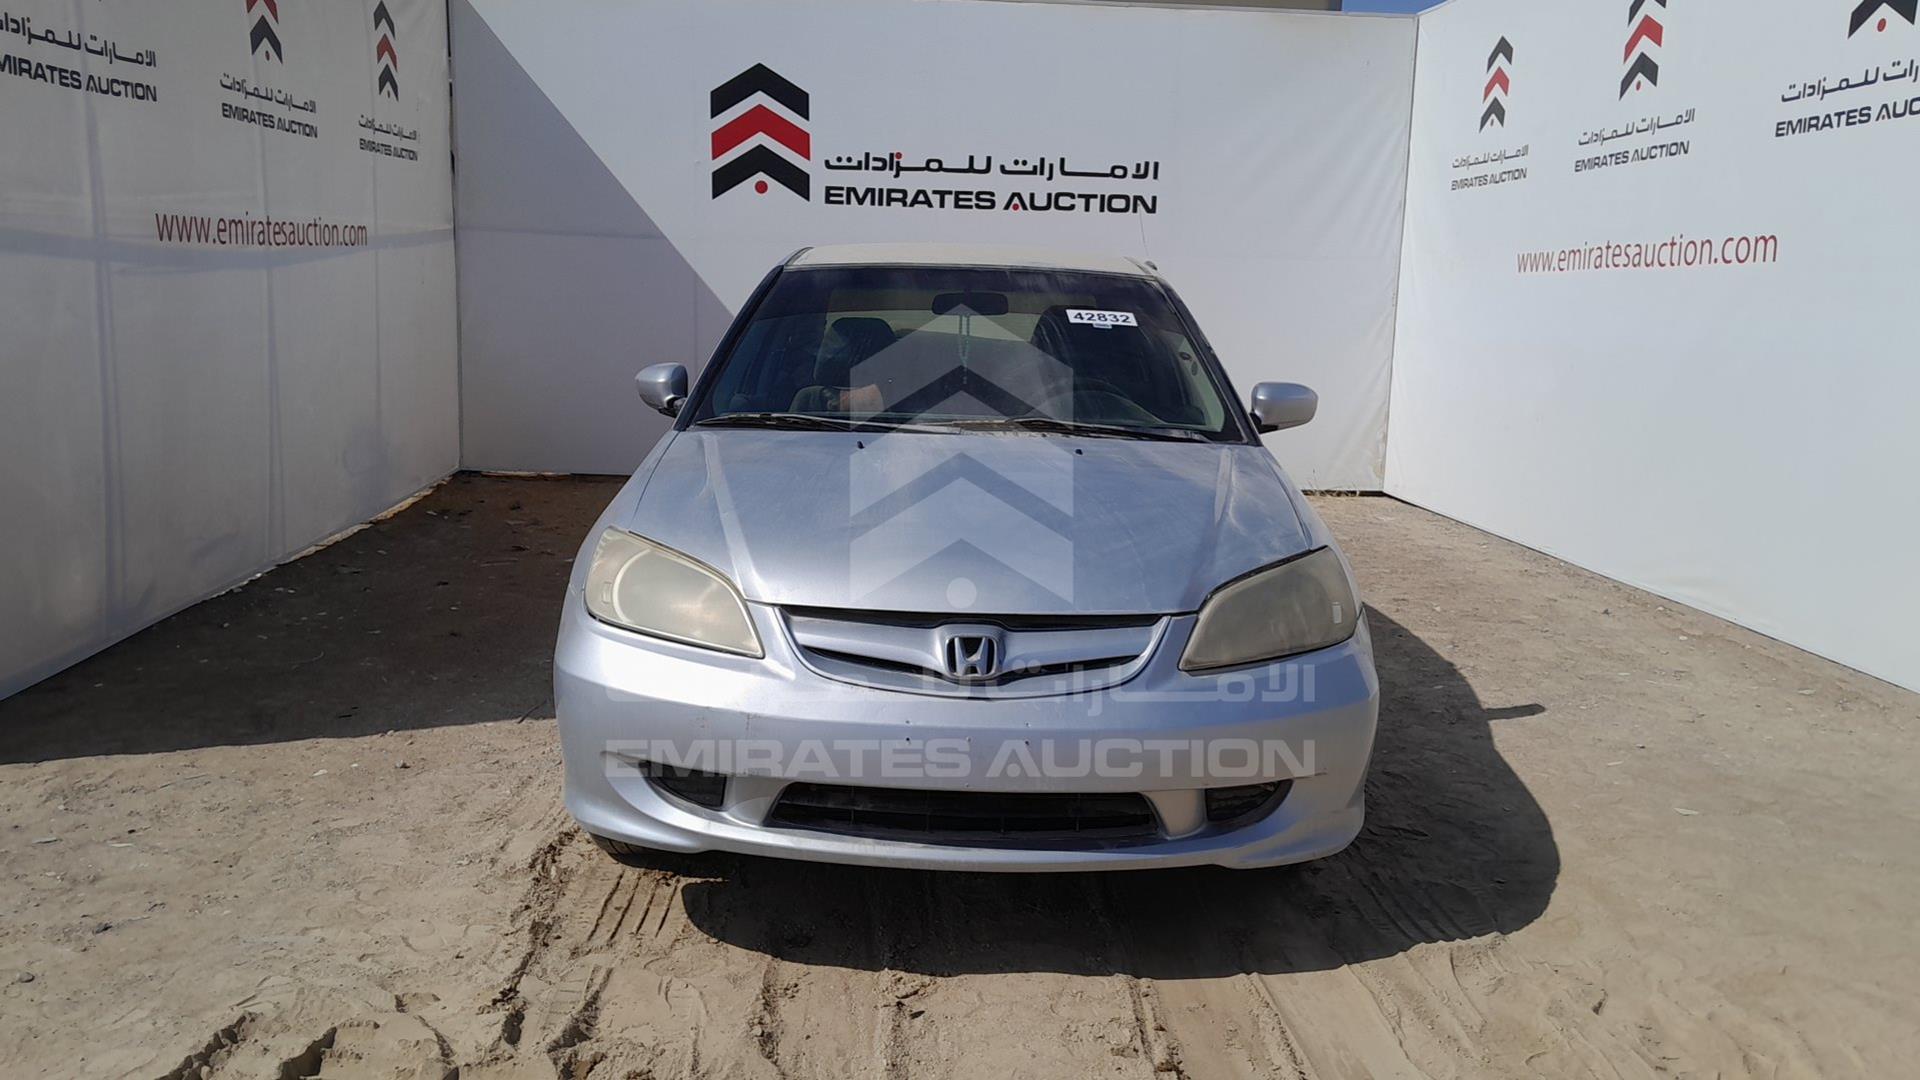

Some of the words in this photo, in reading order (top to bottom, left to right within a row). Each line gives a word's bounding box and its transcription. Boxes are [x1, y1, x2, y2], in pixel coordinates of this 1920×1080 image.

[0, 12, 81, 50] للمزادا
[0, 54, 82, 89] MIRATES
[86, 75, 157, 102] AUCTION
[1782, 67, 1879, 102] للمزادات
[222, 102, 275, 128] EMIRATES
[277, 117, 317, 138] AUCTION
[1775, 106, 1871, 137] EMIRATES
[360, 138, 392, 156] EMIRATES
[1575, 151, 1629, 172] EMIRATES
[1631, 141, 1689, 161] AUCTION
[825, 152, 991, 178] للمزادات
[1000, 157, 1159, 181] الامارات
[1451, 174, 1488, 190] EMIRATES
[1489, 168, 1527, 184] AUCTION
[825, 186, 996, 209] EMIRATES
[1003, 192, 1157, 214] AUCTION
[155, 212, 367, 246] www.emiratesauction.com
[1518, 234, 1777, 272] www.emiratesauction.com
[1073, 312, 1132, 324] 42832
